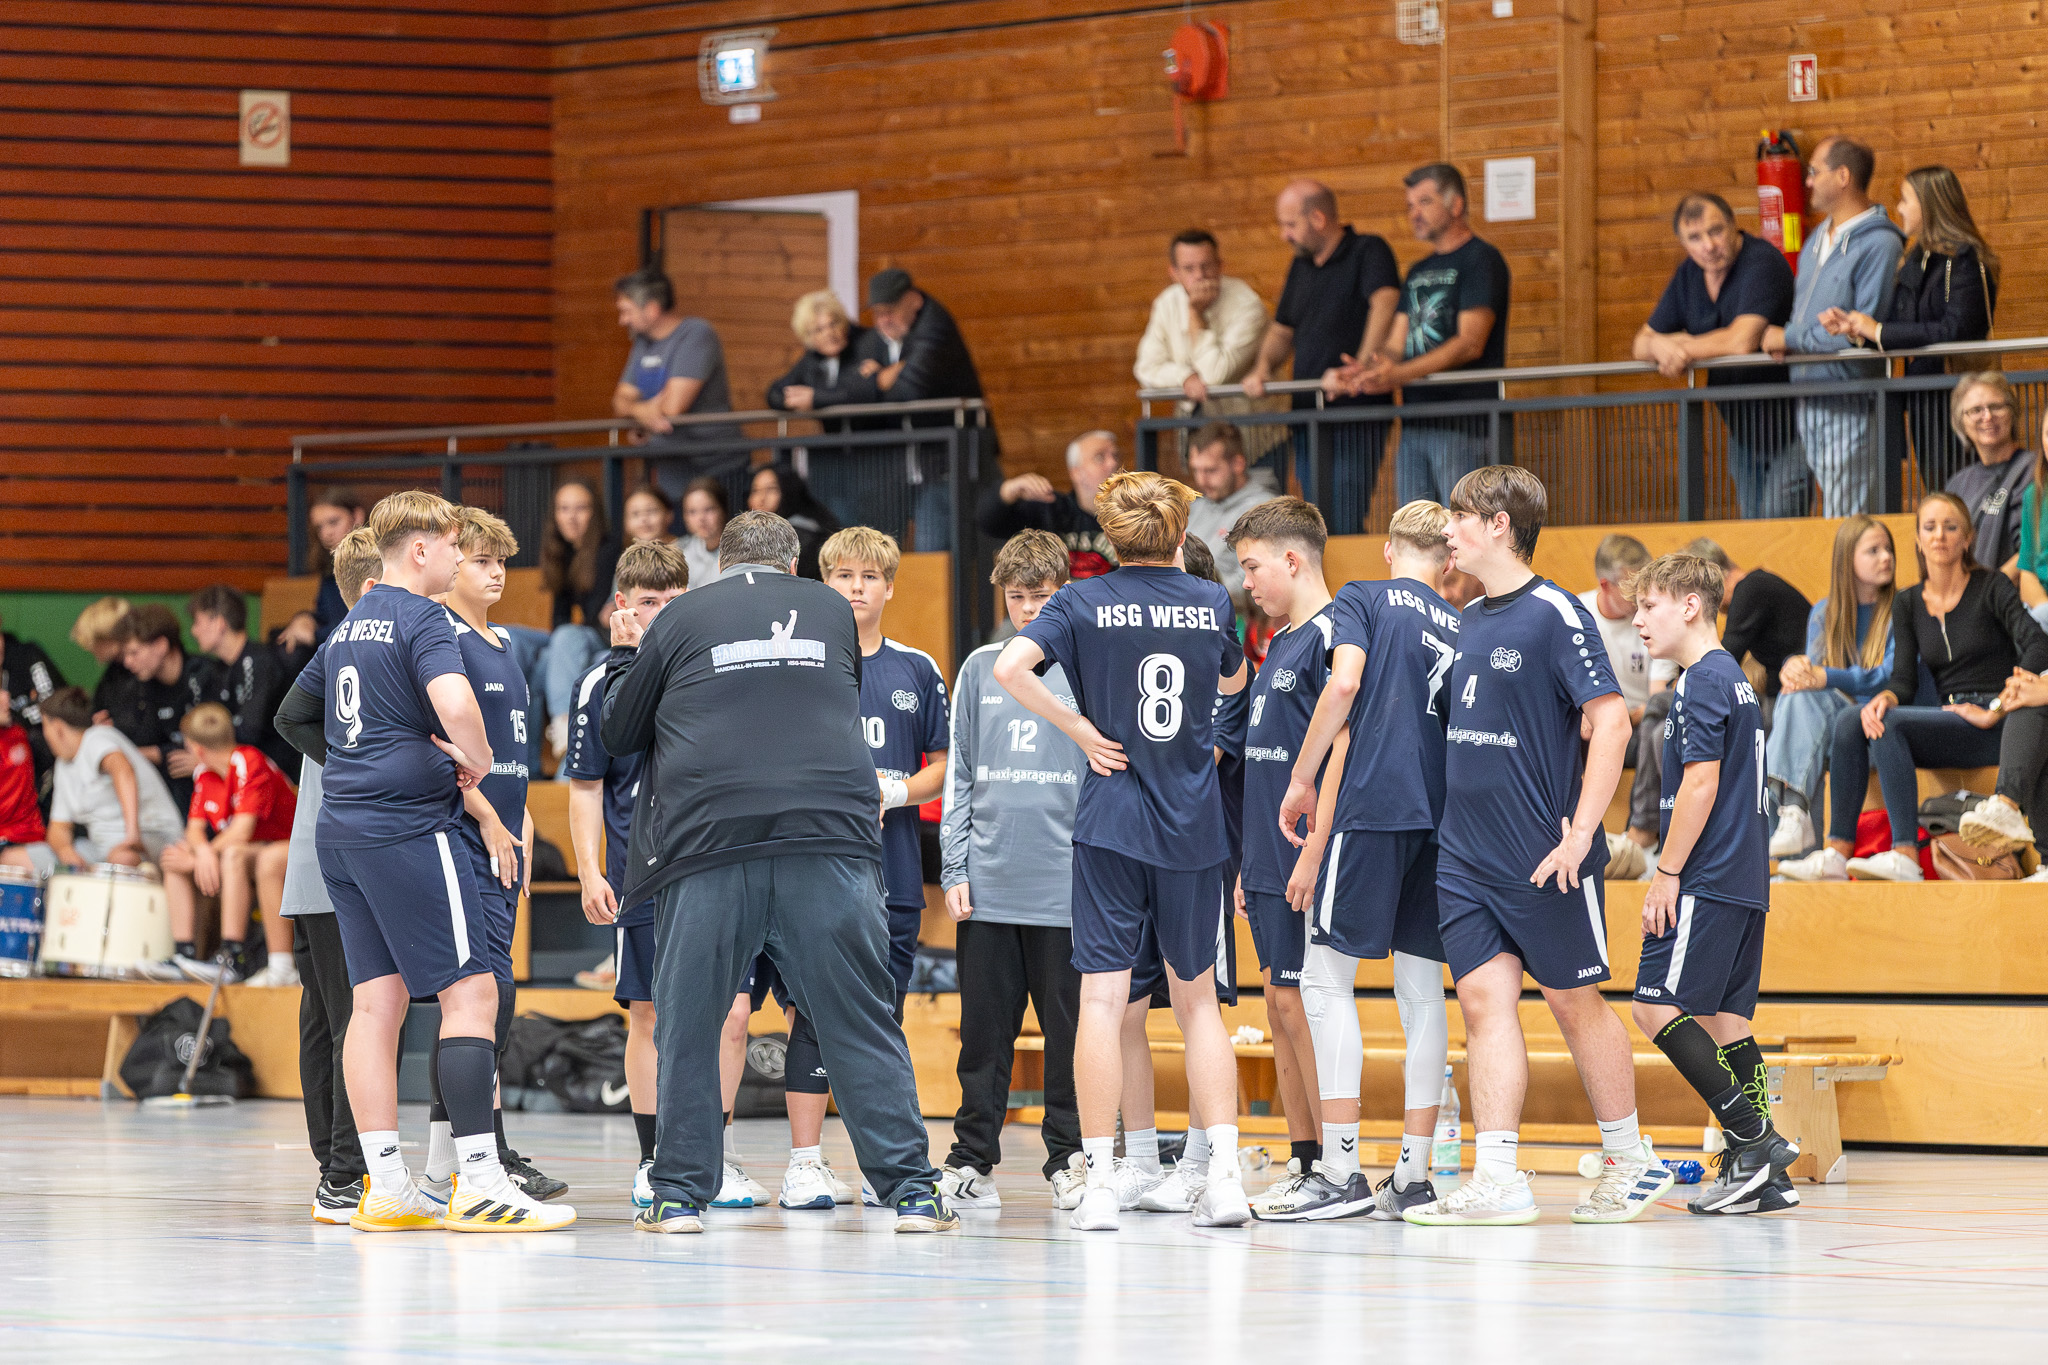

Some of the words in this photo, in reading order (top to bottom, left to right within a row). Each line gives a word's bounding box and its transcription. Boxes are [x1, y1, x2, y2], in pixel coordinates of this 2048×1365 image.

[1097, 604, 1142, 628] HSG
[1149, 605, 1220, 632] WESEL
[1387, 589, 1427, 616] HSG
[1428, 603, 1460, 634] WE
[348, 618, 395, 644] WESEL
[484, 682, 505, 692] JAKO
[1421, 630, 1456, 718] 7
[981, 695, 1004, 705] JAKO
[1137, 653, 1185, 742] 8
[1460, 674, 1478, 709] 4
[1734, 681, 1760, 706] HS
[335, 665, 364, 749] 9
[509, 708, 527, 745] 15
[1007, 718, 1038, 752] 12
[988, 766, 1078, 784] maxi-garagen.de
[1577, 965, 1603, 979] JAKO
[1638, 986, 1662, 998] JAKO
[469, 1151, 488, 1160] NIKE
[1268, 1203, 1295, 1211] Kempa
